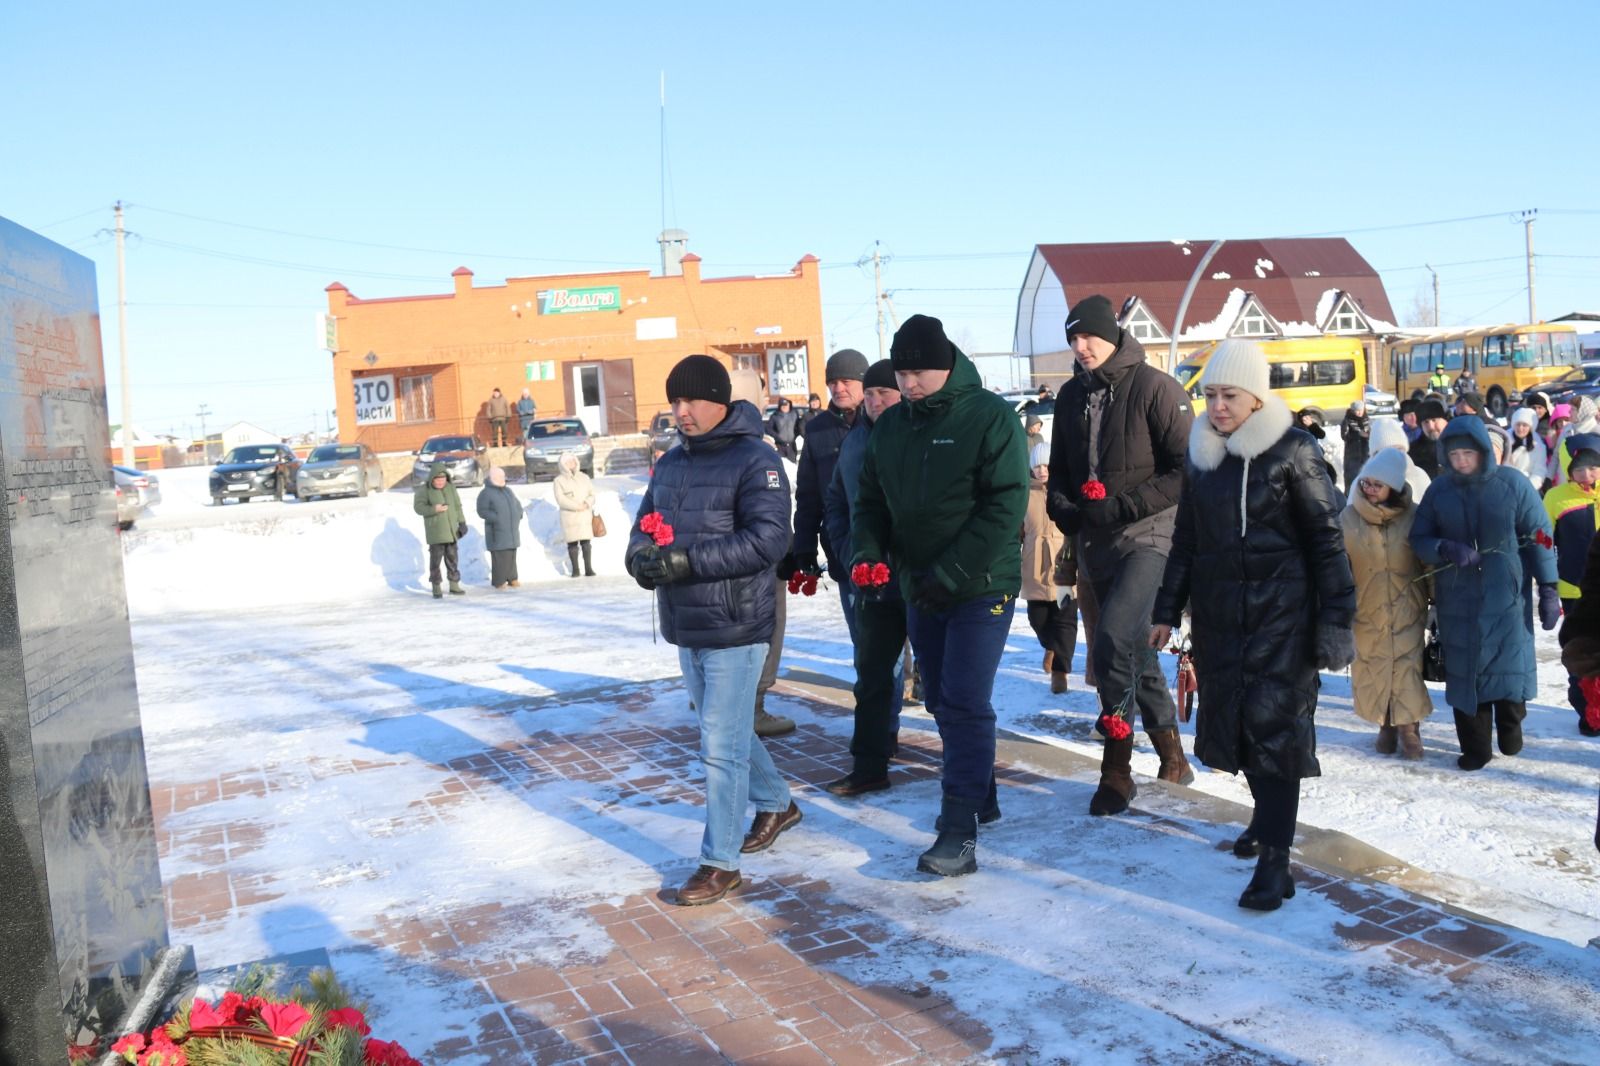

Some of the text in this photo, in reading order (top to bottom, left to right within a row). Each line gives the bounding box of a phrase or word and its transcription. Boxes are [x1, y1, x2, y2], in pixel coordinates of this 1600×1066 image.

[551, 290, 615, 308] Волга
[773, 378, 805, 390] ЗАПЧА
[356, 405, 392, 420] ЧАСТИ
